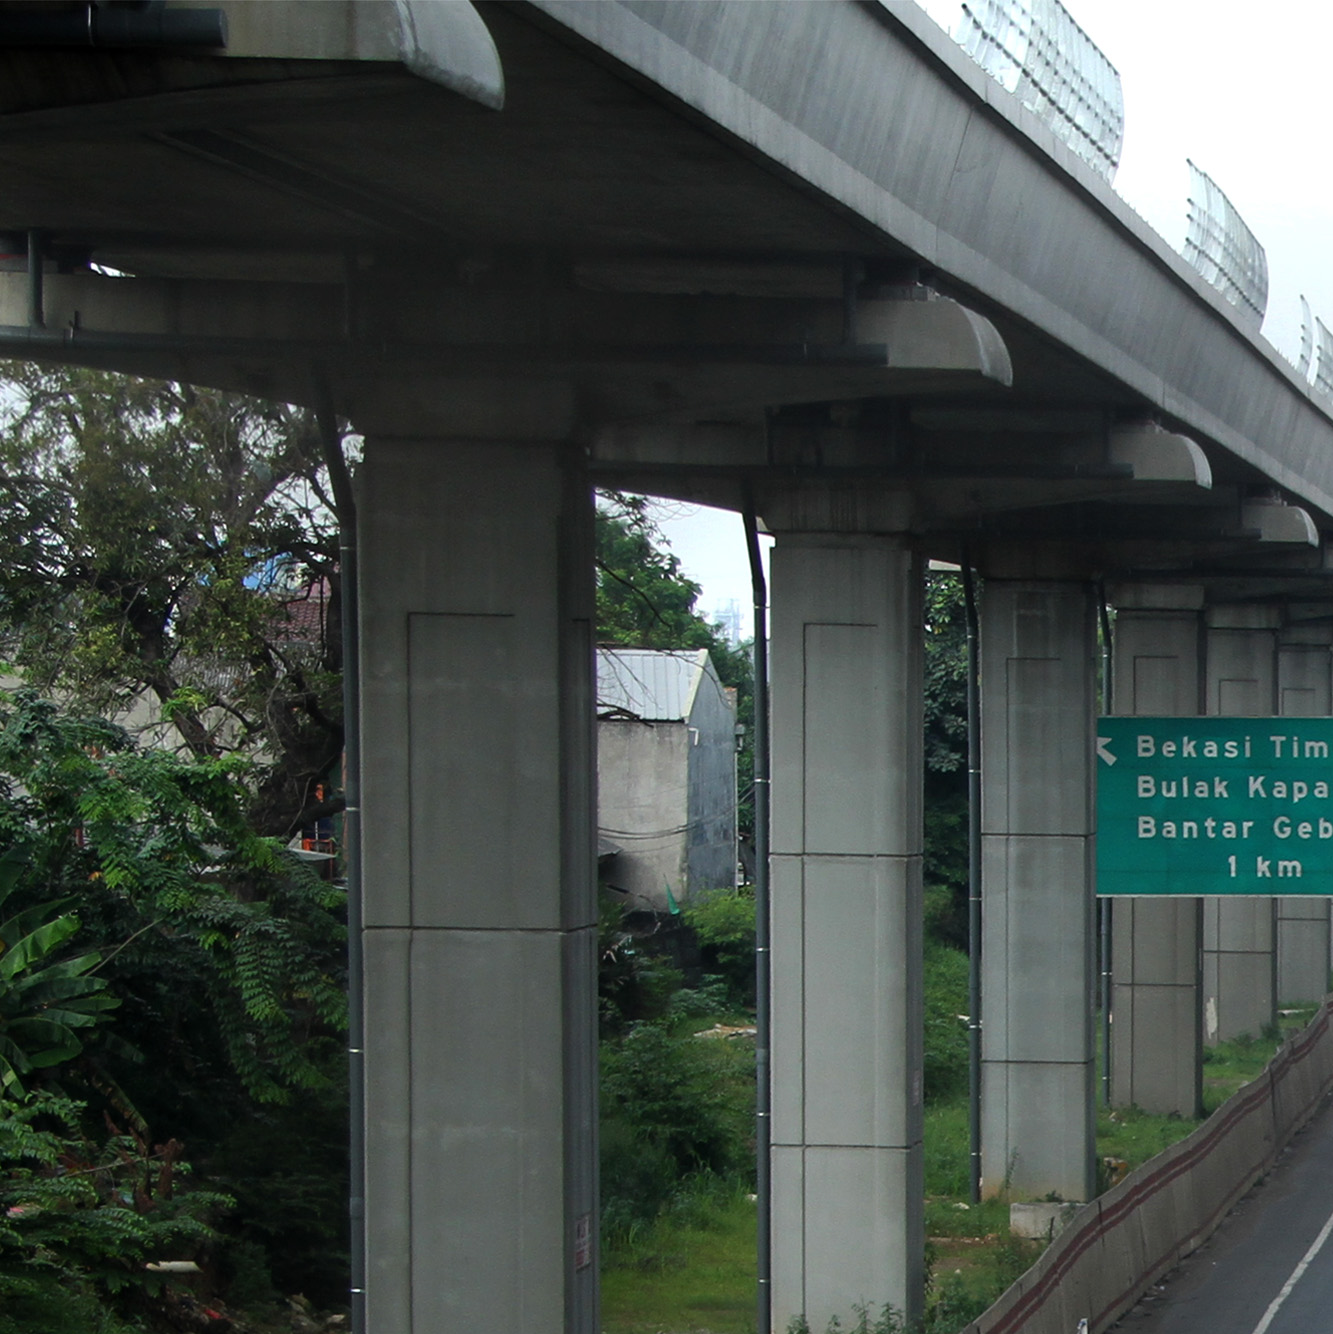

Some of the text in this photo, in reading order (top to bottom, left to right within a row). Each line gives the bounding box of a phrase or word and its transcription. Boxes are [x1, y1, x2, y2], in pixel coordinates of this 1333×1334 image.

[1137, 735, 1251, 758] Bekasi
[1137, 775, 1230, 798] Bulak
[1138, 816, 1255, 839] Bantar
[1228, 855, 1303, 878] 1 km
